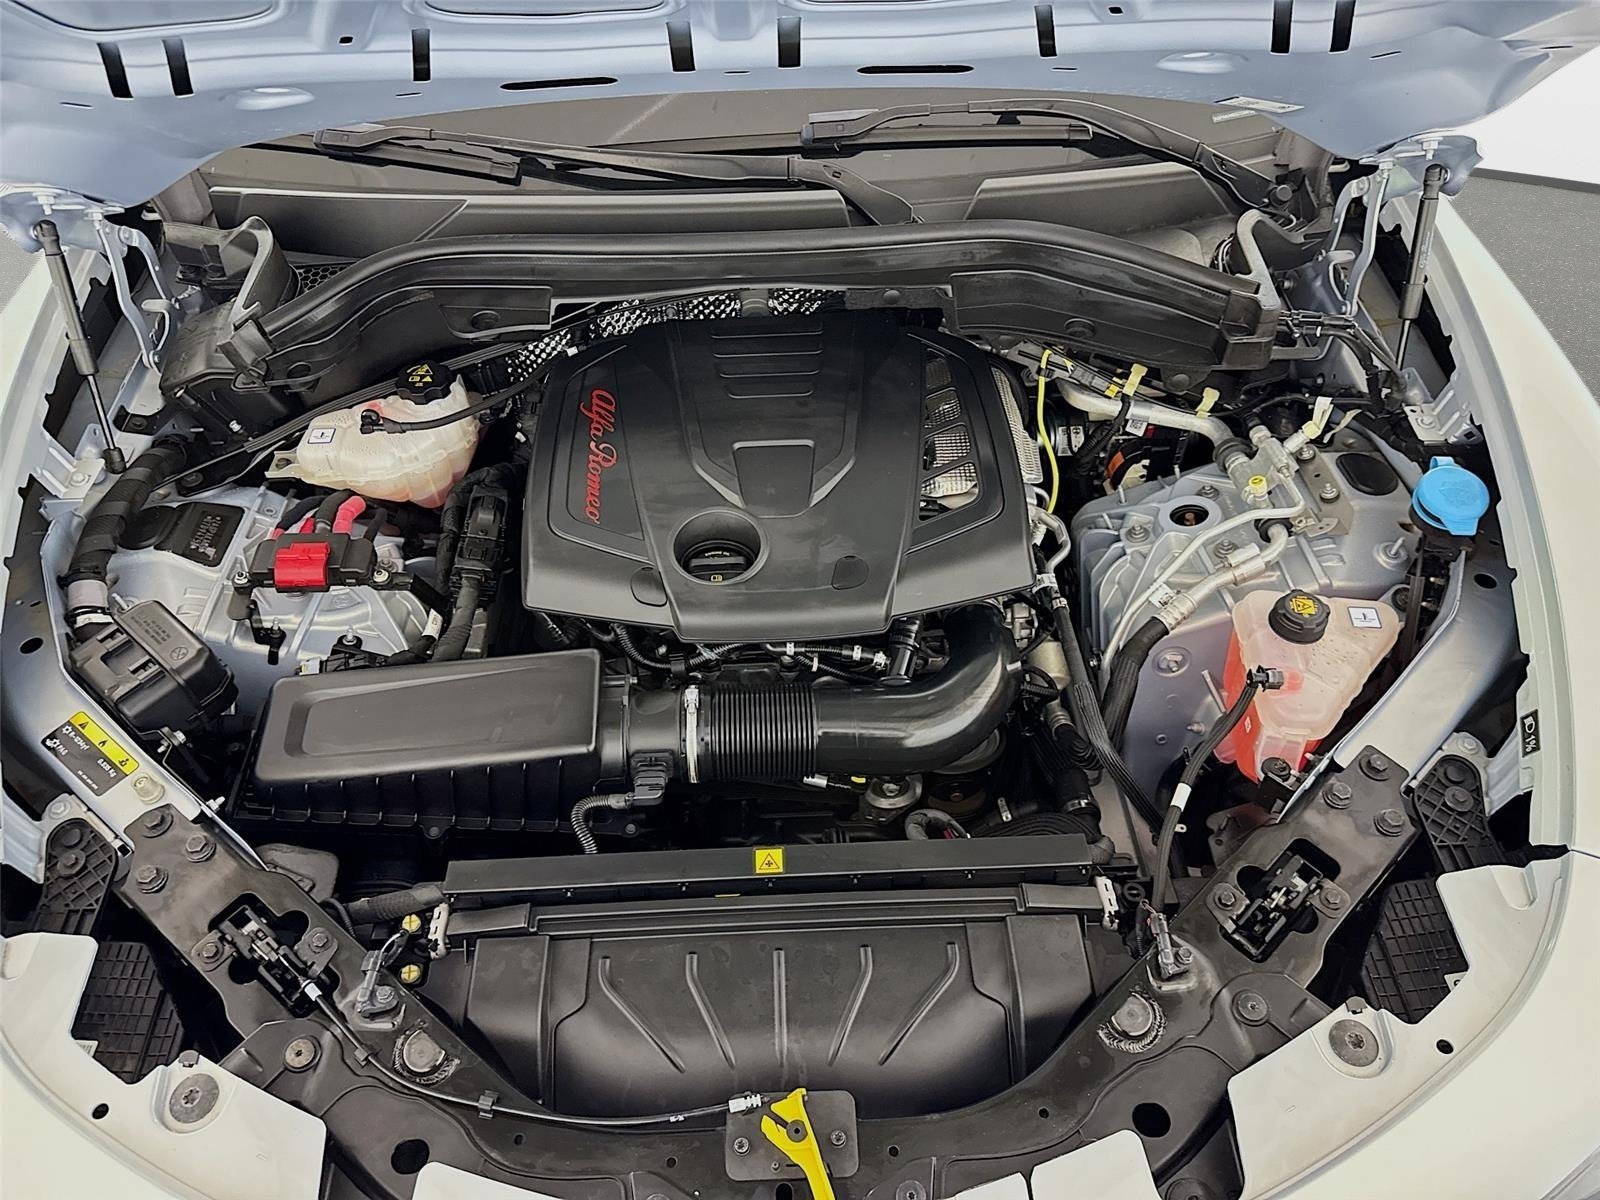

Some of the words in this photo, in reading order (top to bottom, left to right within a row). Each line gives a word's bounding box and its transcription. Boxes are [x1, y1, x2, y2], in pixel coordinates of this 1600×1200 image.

[579, 388, 617, 442] Alfa
[584, 441, 618, 525] Romeo
[1525, 735, 1536, 752] 1%
